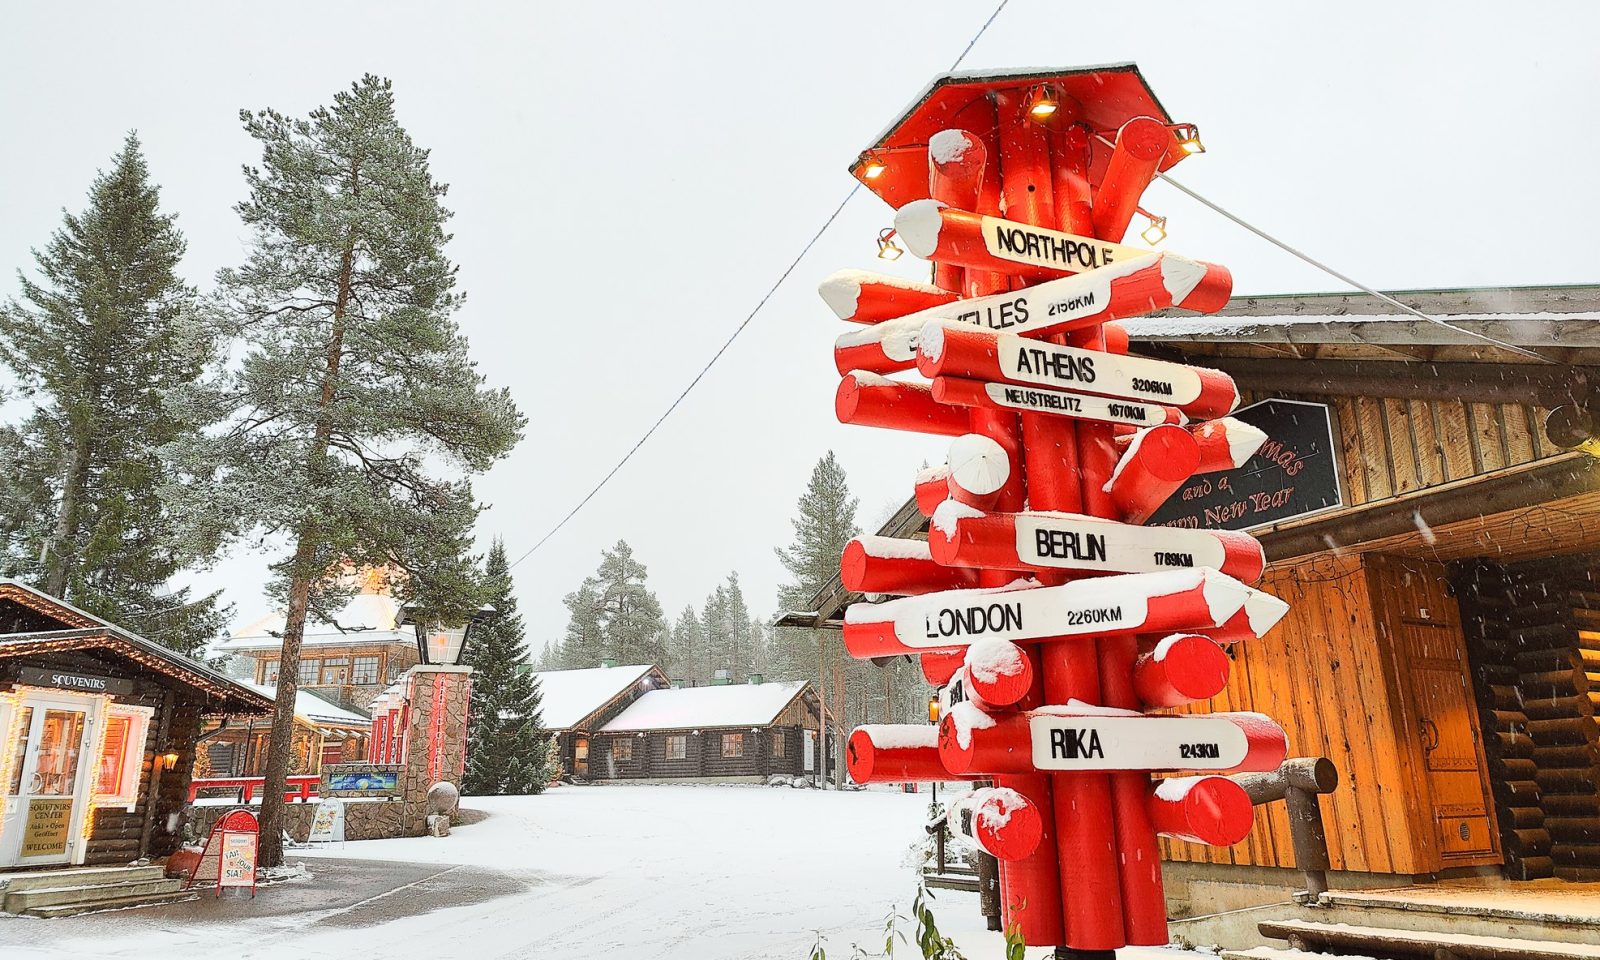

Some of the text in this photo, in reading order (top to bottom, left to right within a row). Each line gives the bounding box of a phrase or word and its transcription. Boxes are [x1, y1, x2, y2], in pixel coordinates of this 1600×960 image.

[996, 226, 1114, 268] NORTHPOLE
[1017, 347, 1173, 396] ATHENS 3206KM
[1005, 388, 1146, 421] NEUSTRELITZ 1670KM
[1182, 476, 1230, 501] and a
[1204, 500, 1248, 527] New
[1249, 487, 1294, 513] Year
[1035, 528, 1107, 562] BERLIN
[926, 602, 1122, 638] LONDON 2260KM
[51, 674, 106, 689] SOUVENIRS
[1179, 743, 1220, 759] 1243KM
[26, 842, 63, 851] WELCOME
